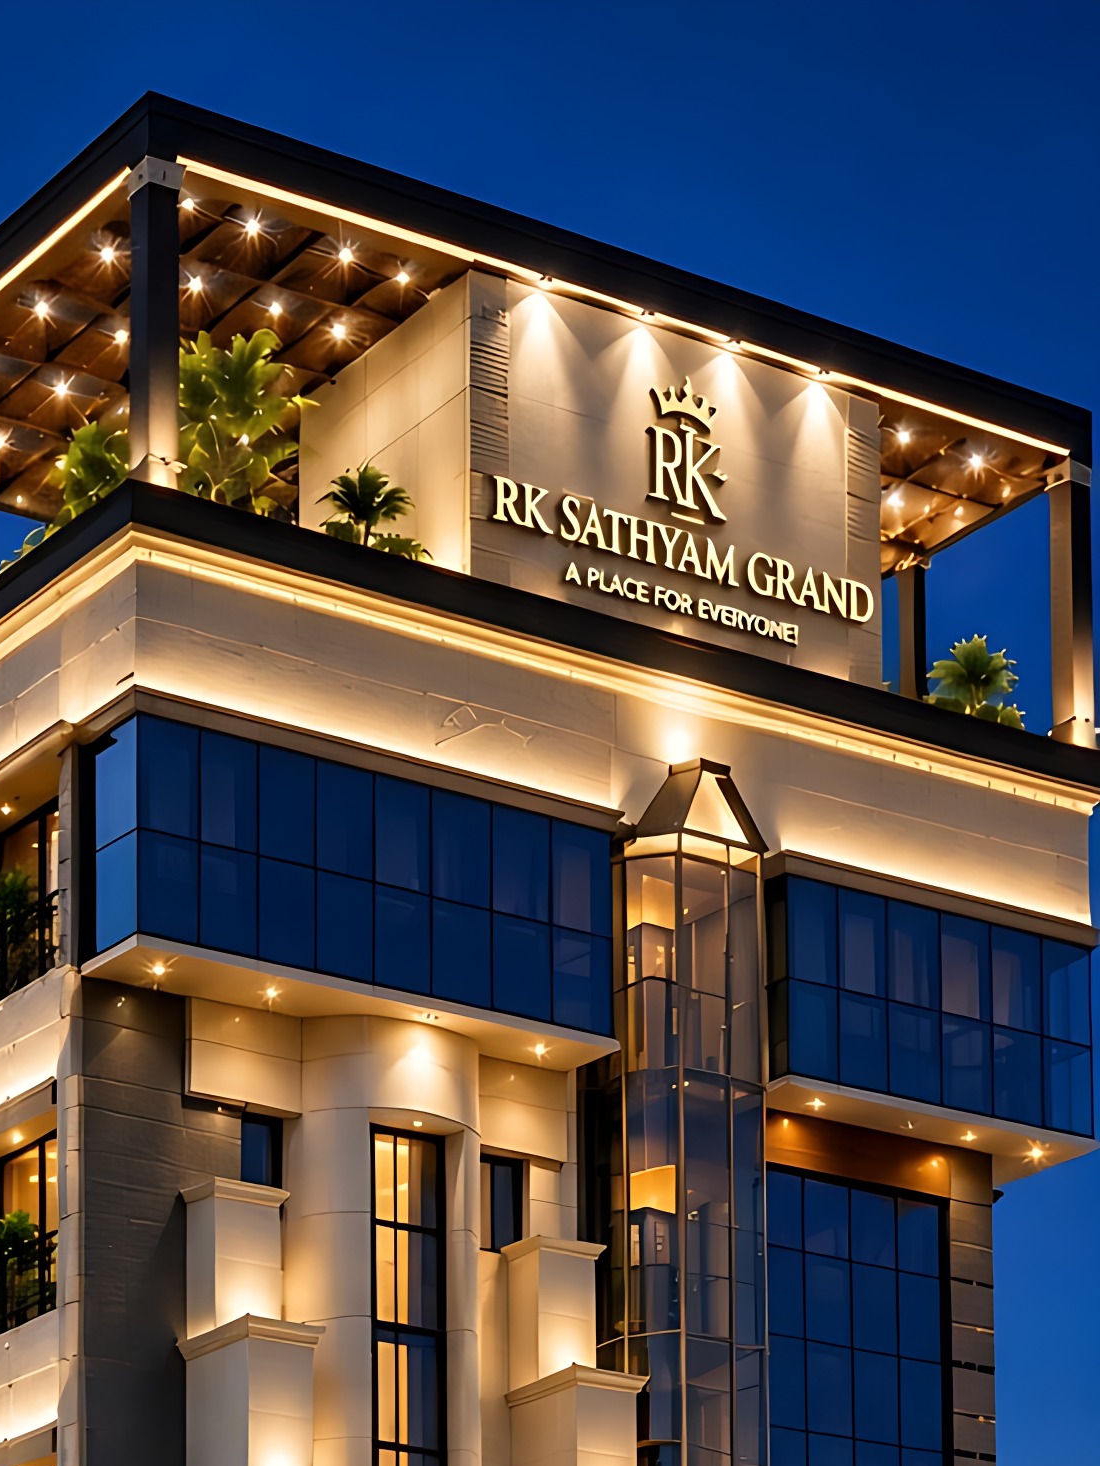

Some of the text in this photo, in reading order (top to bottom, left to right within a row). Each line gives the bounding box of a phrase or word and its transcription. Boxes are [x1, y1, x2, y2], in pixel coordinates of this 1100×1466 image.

[645, 424, 728, 522] RK
[492, 475, 874, 623] RK SATHYAM GRAND
[565, 561, 799, 647] A PLACE FOR EVERYONE!
